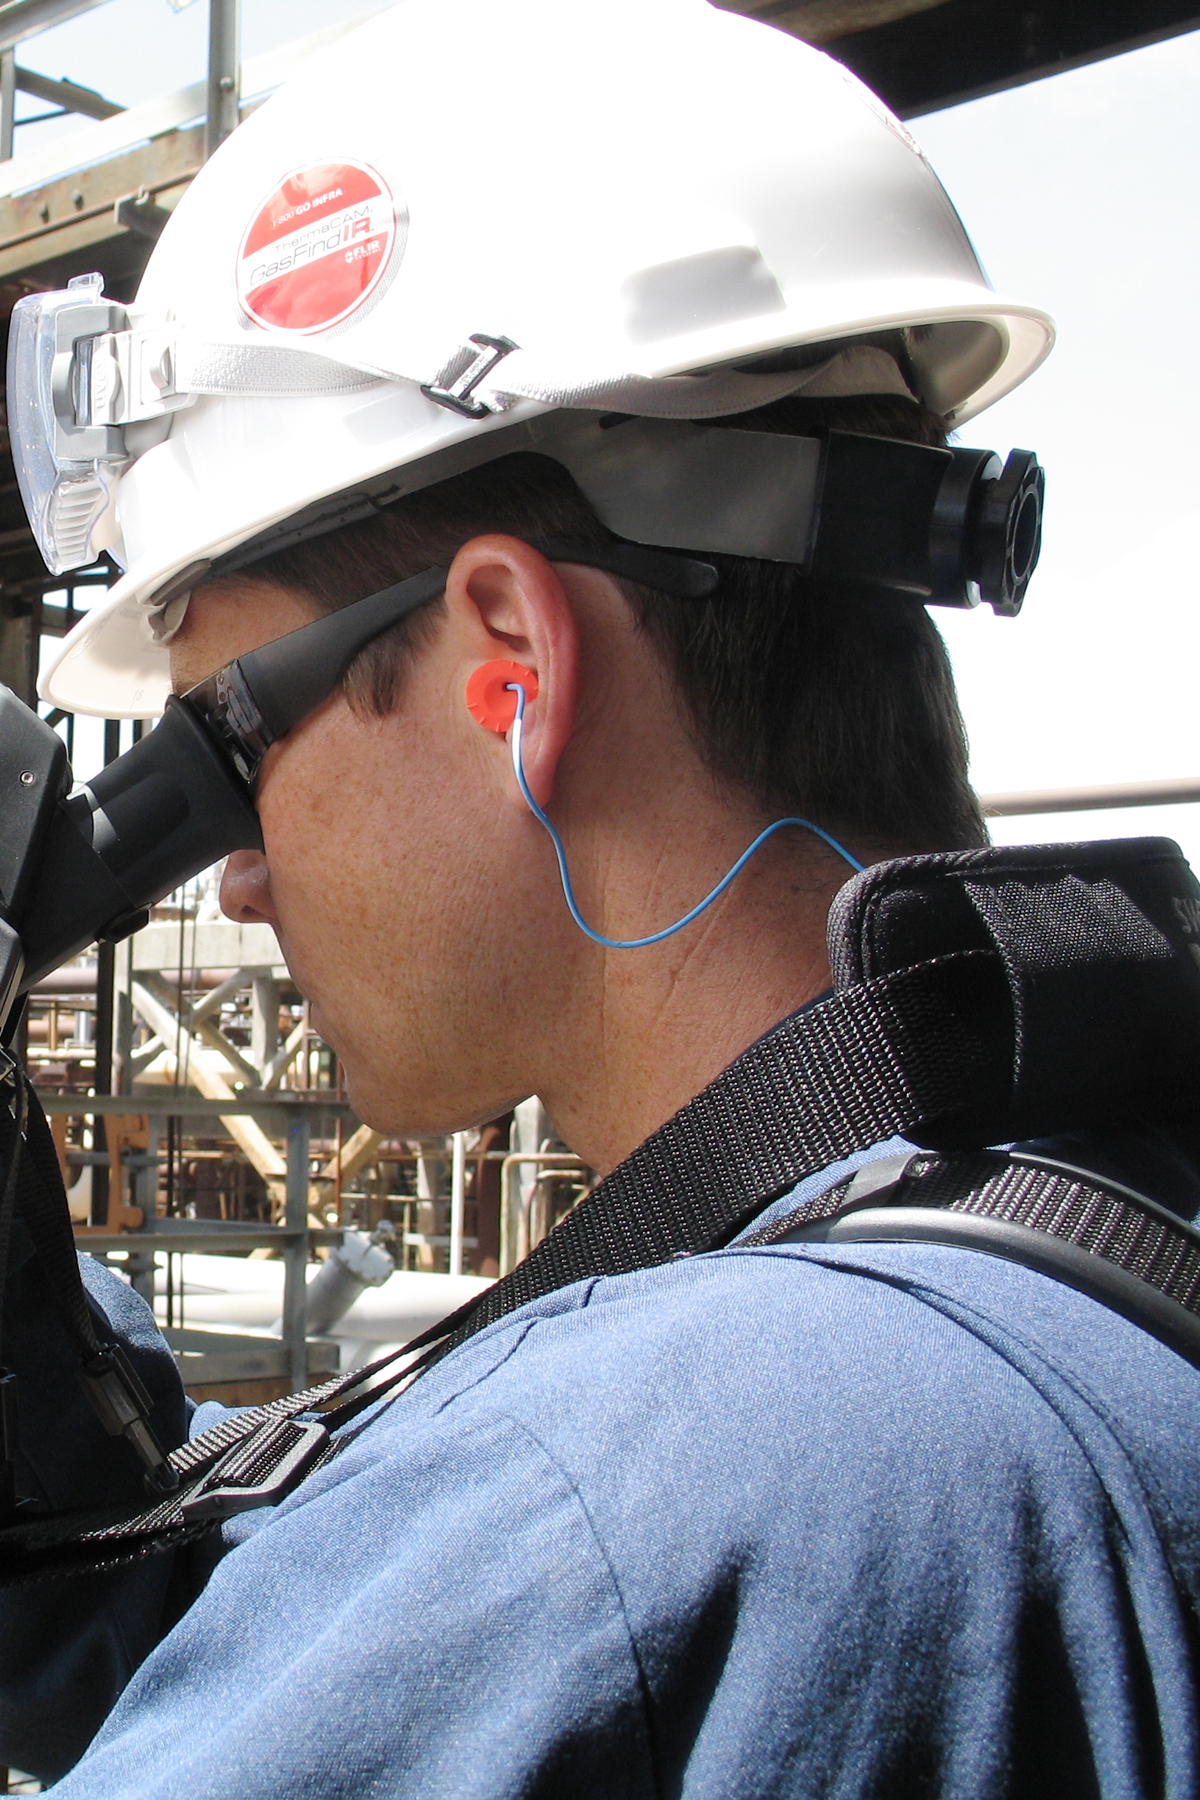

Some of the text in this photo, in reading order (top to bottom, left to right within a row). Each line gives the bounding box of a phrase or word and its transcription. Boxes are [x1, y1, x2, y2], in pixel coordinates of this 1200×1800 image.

[295, 202, 311, 215] GO
[312, 188, 343, 207] INFRA
[250, 216, 372, 286] GasFindIR
[353, 240, 380, 257] FLIR
